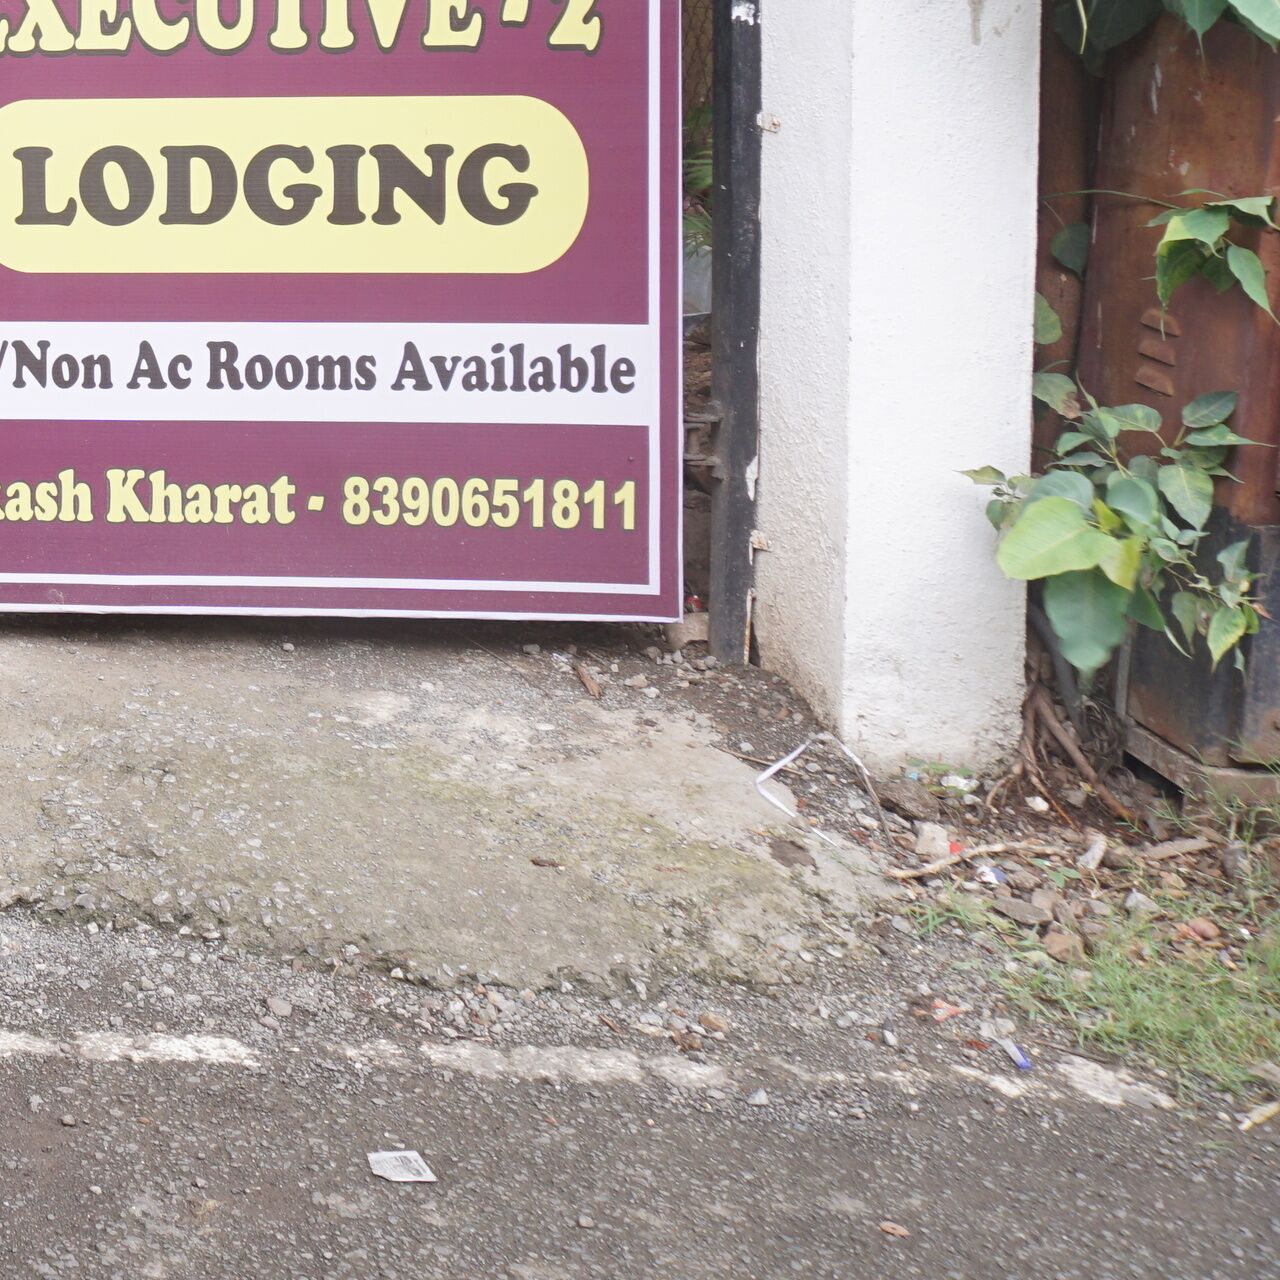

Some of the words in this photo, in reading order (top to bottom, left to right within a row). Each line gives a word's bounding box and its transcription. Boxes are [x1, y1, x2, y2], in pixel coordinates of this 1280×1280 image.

[13, 143, 539, 227] LODGING
[126, 340, 191, 390] Ac
[206, 341, 375, 391] Rooms
[391, 342, 635, 394] Available
[105, 468, 297, 525] Kharat
[342, 476, 636, 531] 8390651811
